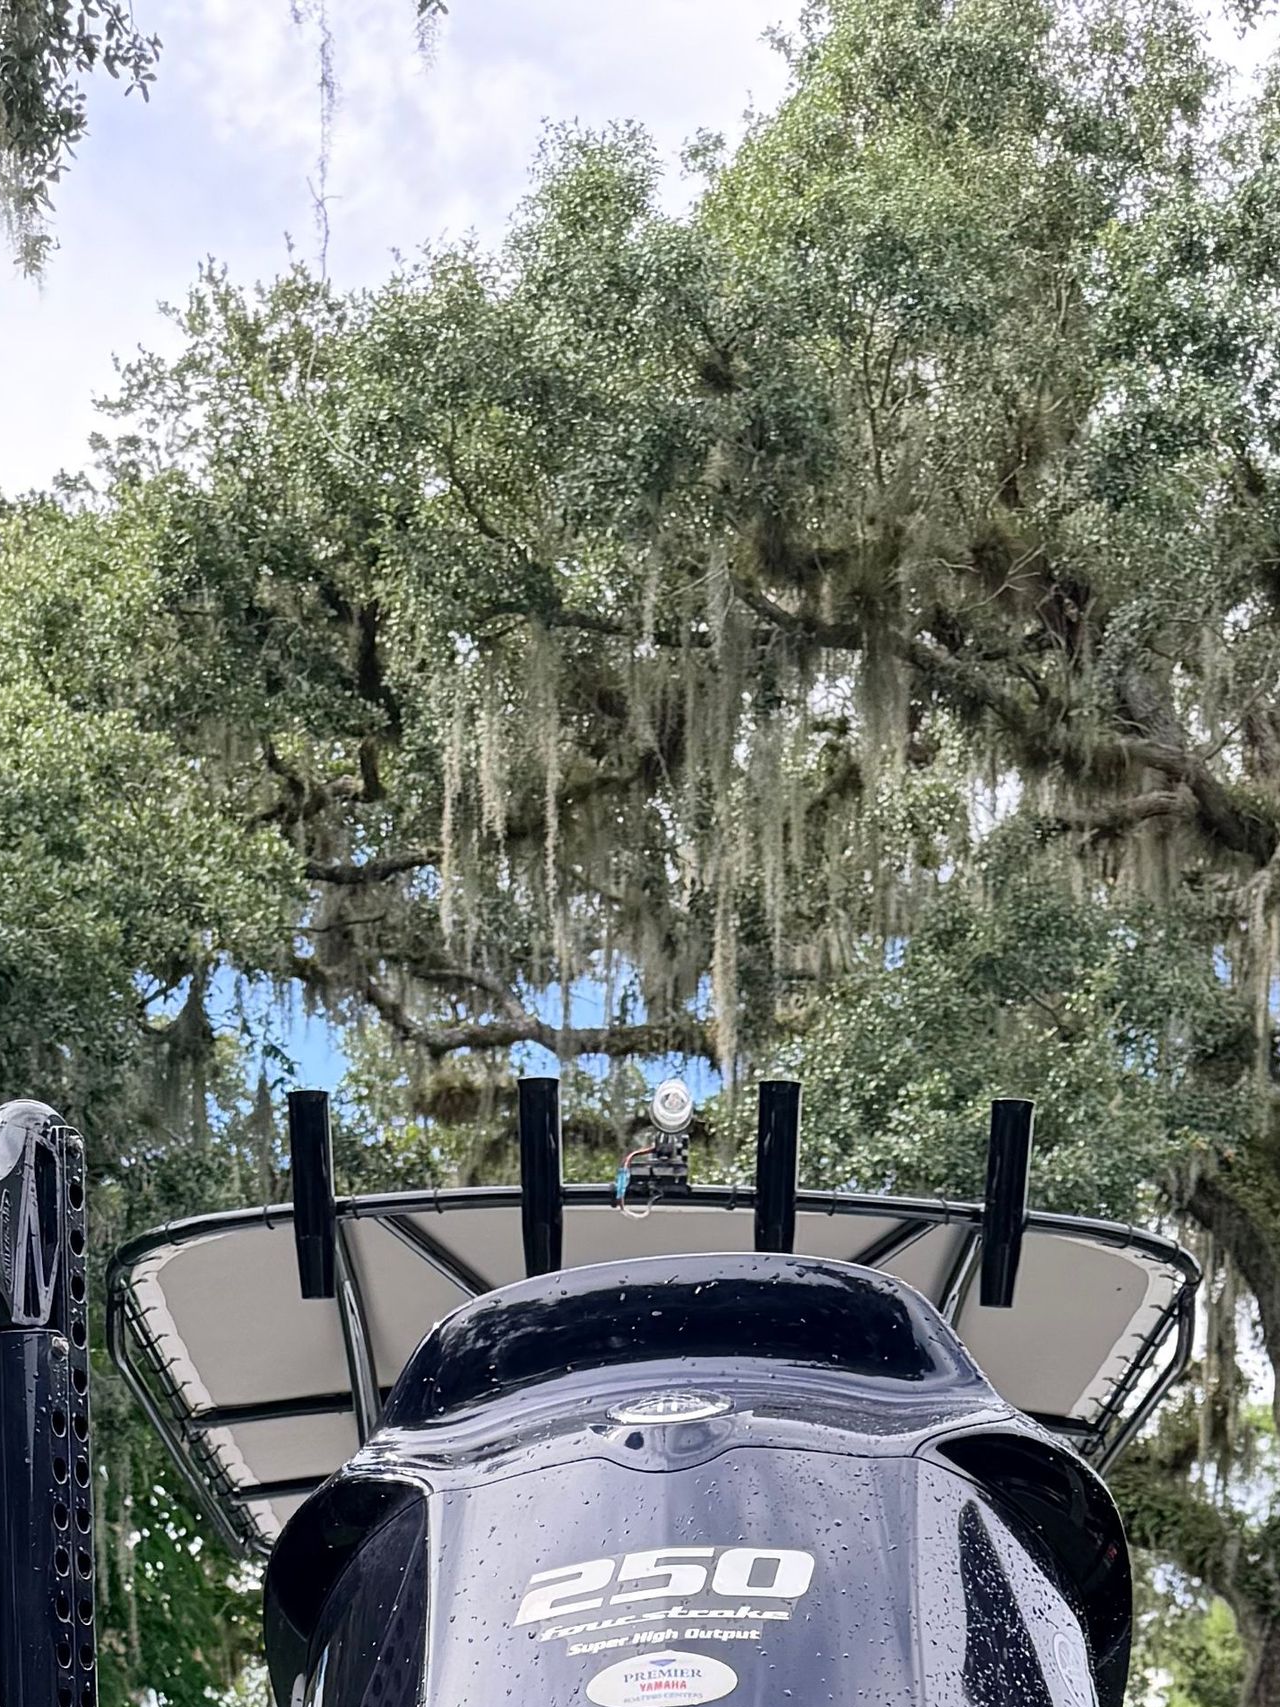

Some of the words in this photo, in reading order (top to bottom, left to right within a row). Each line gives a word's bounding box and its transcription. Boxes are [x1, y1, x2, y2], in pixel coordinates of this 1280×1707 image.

[512, 1547, 816, 1627] 250
[567, 1636, 629, 1656] Super
[632, 1628, 680, 1645] High
[684, 1628, 761, 1641] Output
[623, 1668, 703, 1683] PREMIER
[639, 1680, 688, 1692] YAMAHA
